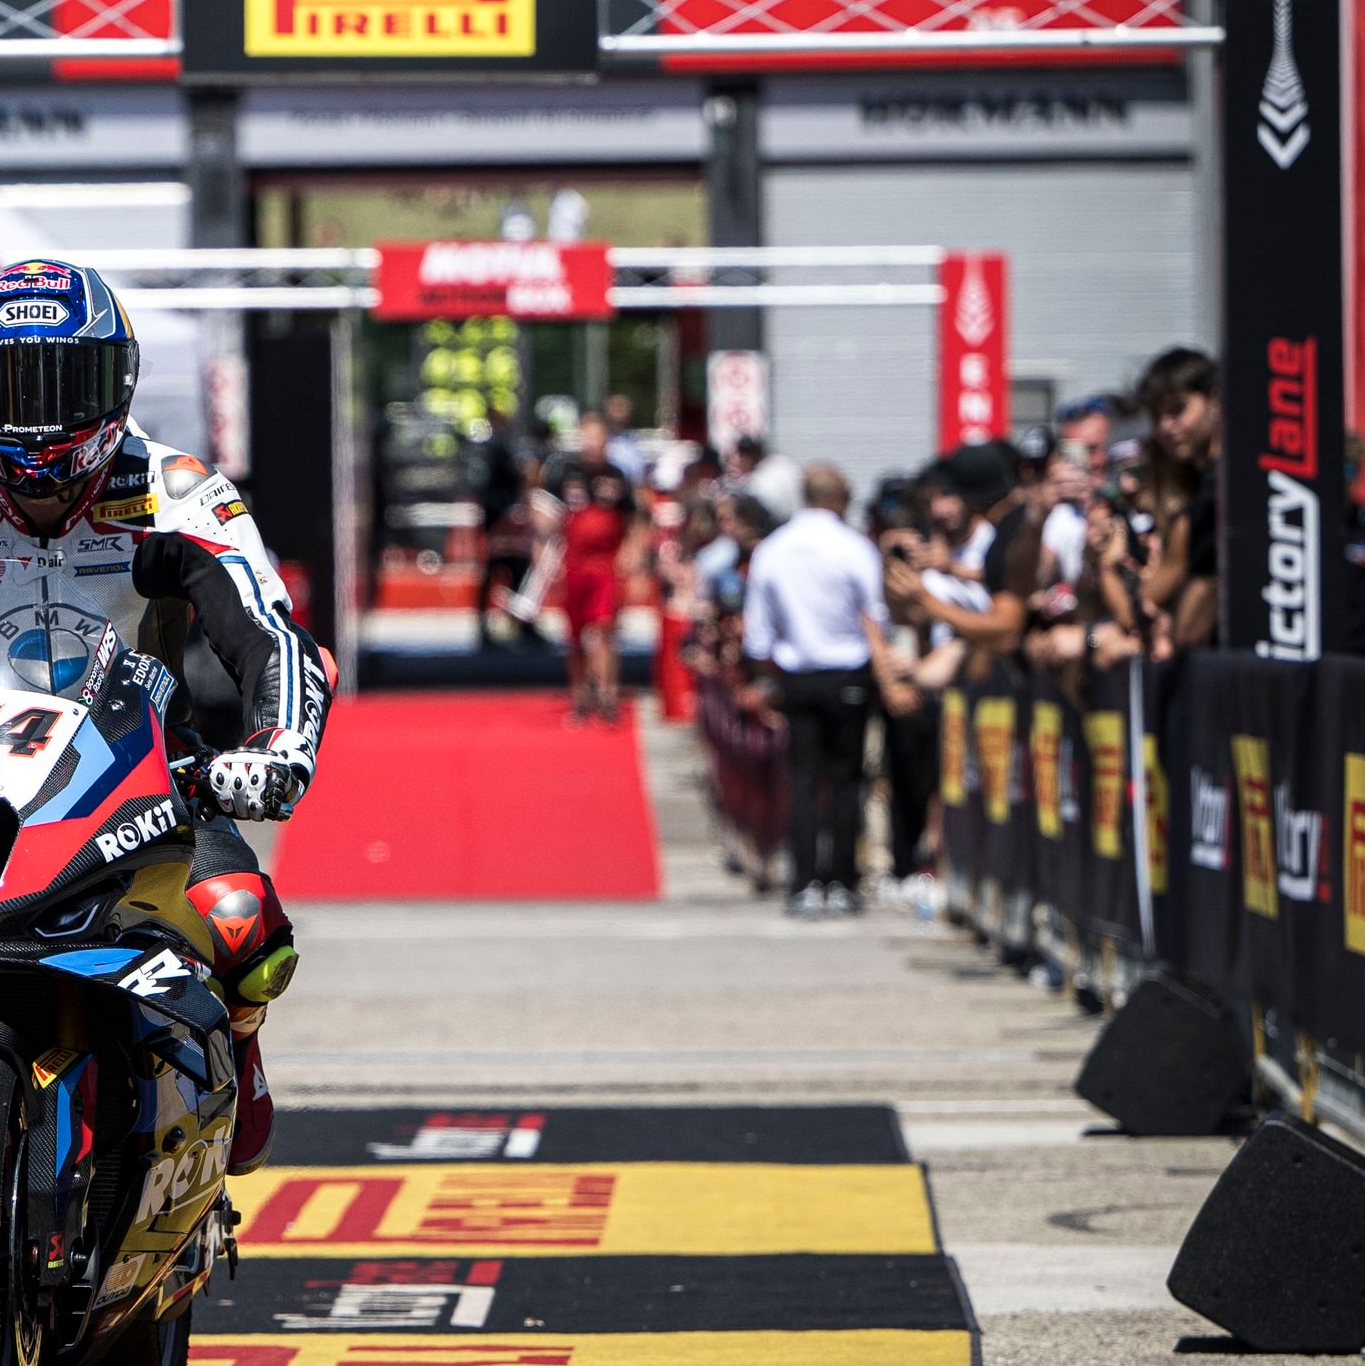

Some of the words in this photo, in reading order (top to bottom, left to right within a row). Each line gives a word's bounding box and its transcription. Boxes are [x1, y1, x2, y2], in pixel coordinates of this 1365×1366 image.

[33, 275, 71, 290] Bull
[5, 304, 58, 321] SHOEI
[19, 336, 42, 344] YOU
[45, 336, 80, 344] WINGS
[100, 497, 153, 519] PIRELLI
[132, 656, 152, 686] EDOX
[95, 798, 178, 863] ROKiT
